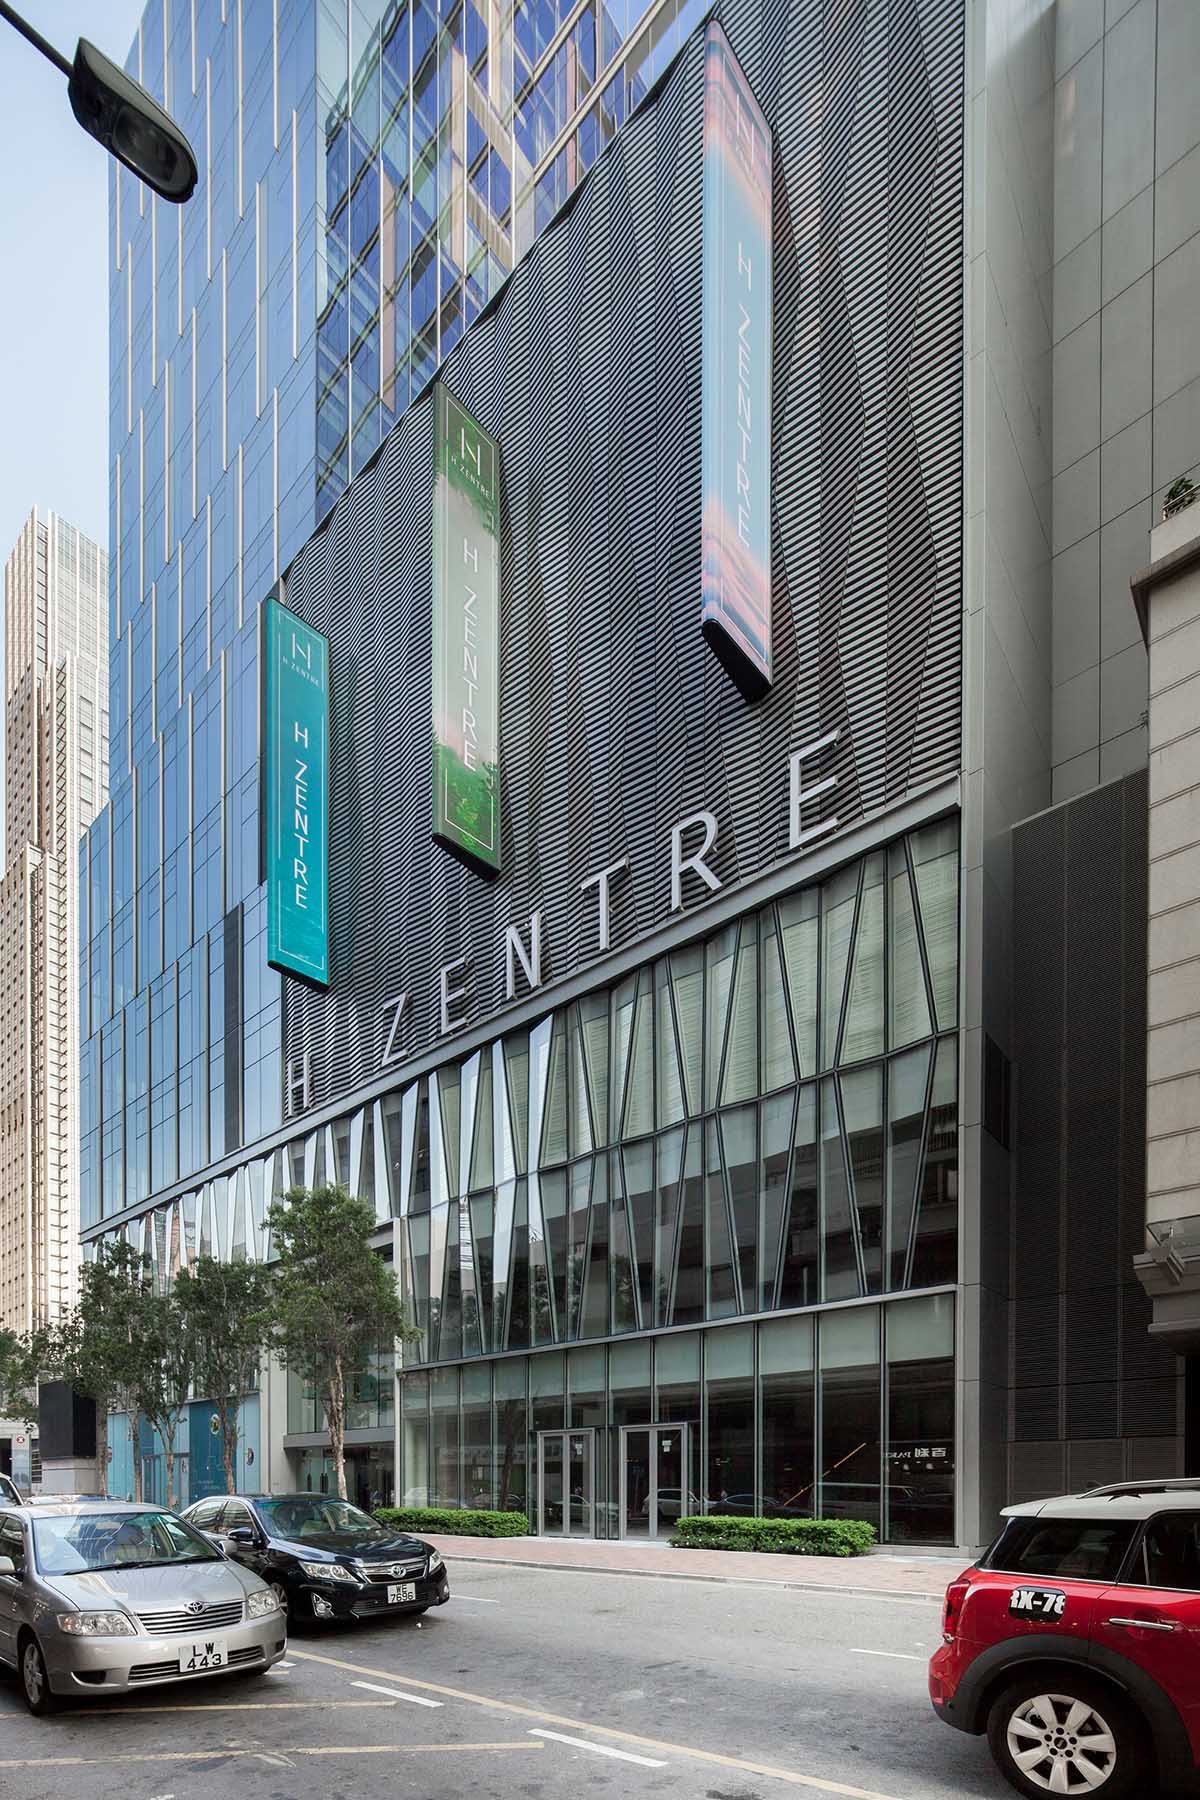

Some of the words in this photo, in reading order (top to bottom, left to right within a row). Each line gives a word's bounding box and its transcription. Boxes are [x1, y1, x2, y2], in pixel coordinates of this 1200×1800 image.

[736, 303, 752, 547] ZENTRE
[463, 537, 478, 573] H
[463, 585, 479, 772] ZENTRE
[294, 721, 309, 749] H
[293, 759, 309, 909] ZENTRE
[287, 1052, 313, 1117] H
[381, 729, 844, 1067] ZENTRE
[390, 1591, 415, 1602] 7696
[187, 1653, 222, 1670] 443
